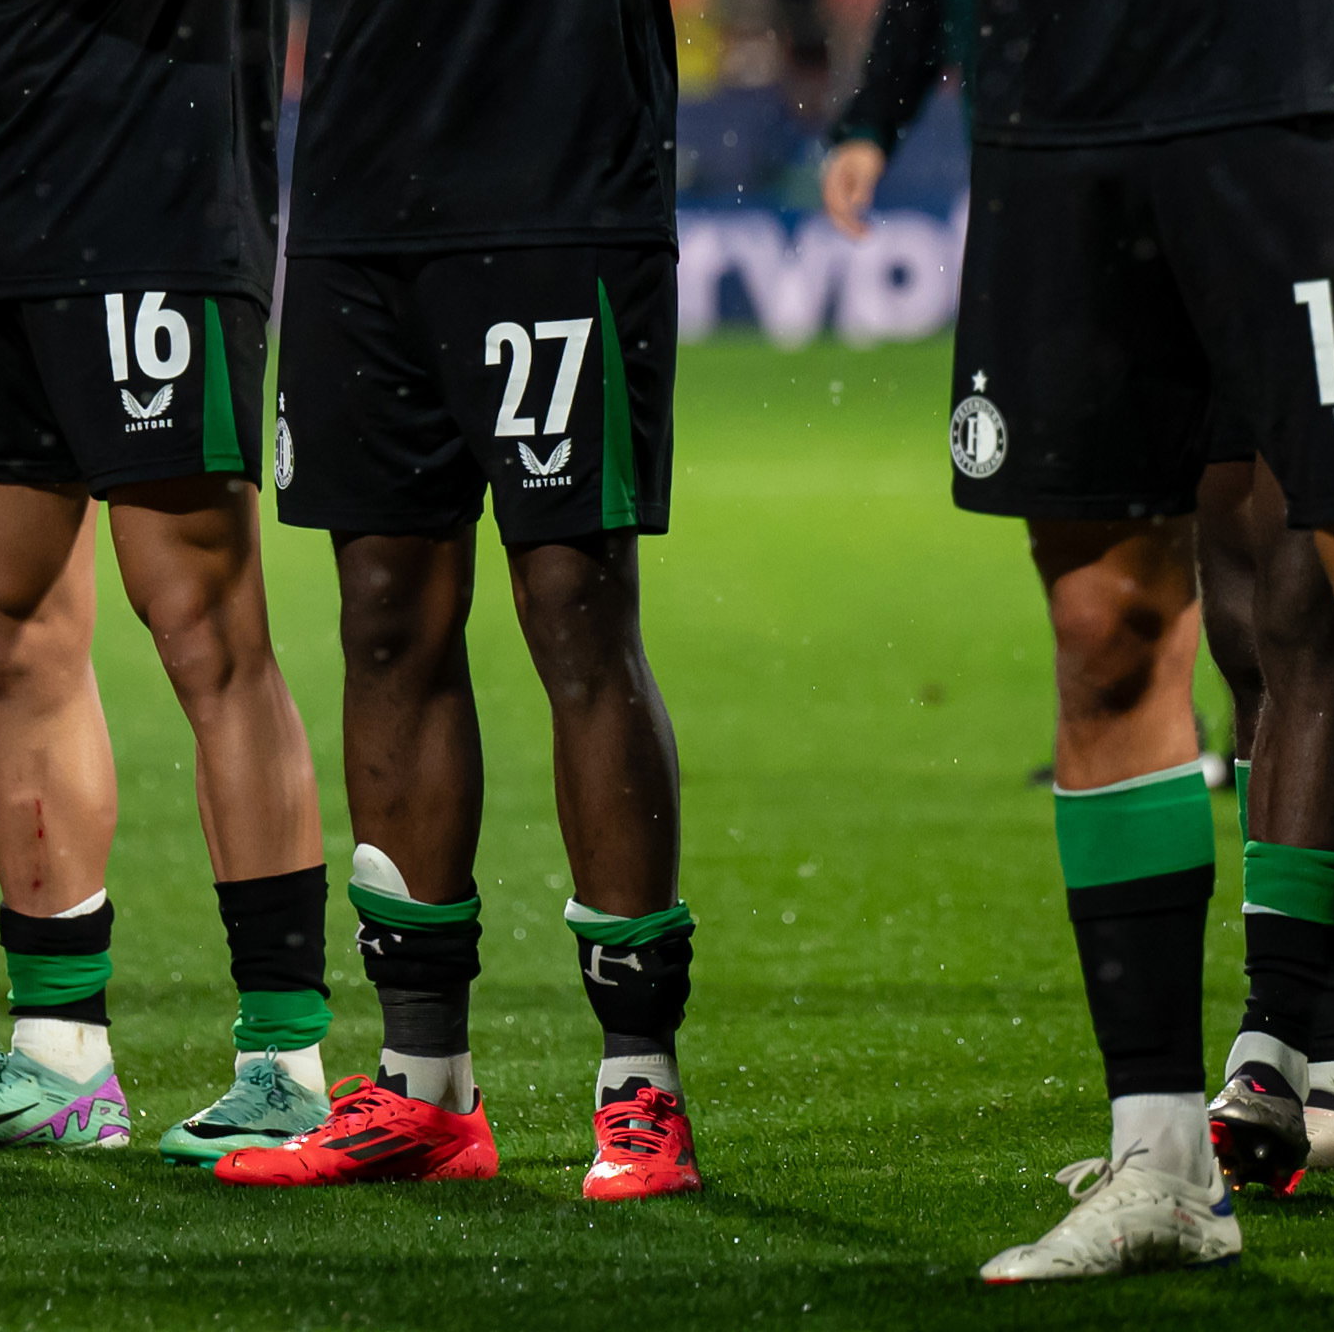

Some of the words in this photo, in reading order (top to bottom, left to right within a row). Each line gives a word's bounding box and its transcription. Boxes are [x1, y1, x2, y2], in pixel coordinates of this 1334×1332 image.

[105, 291, 191, 382] 16
[484, 318, 594, 437] 27
[125, 418, 174, 433] CASTORE
[522, 475, 572, 489] CASTORE
